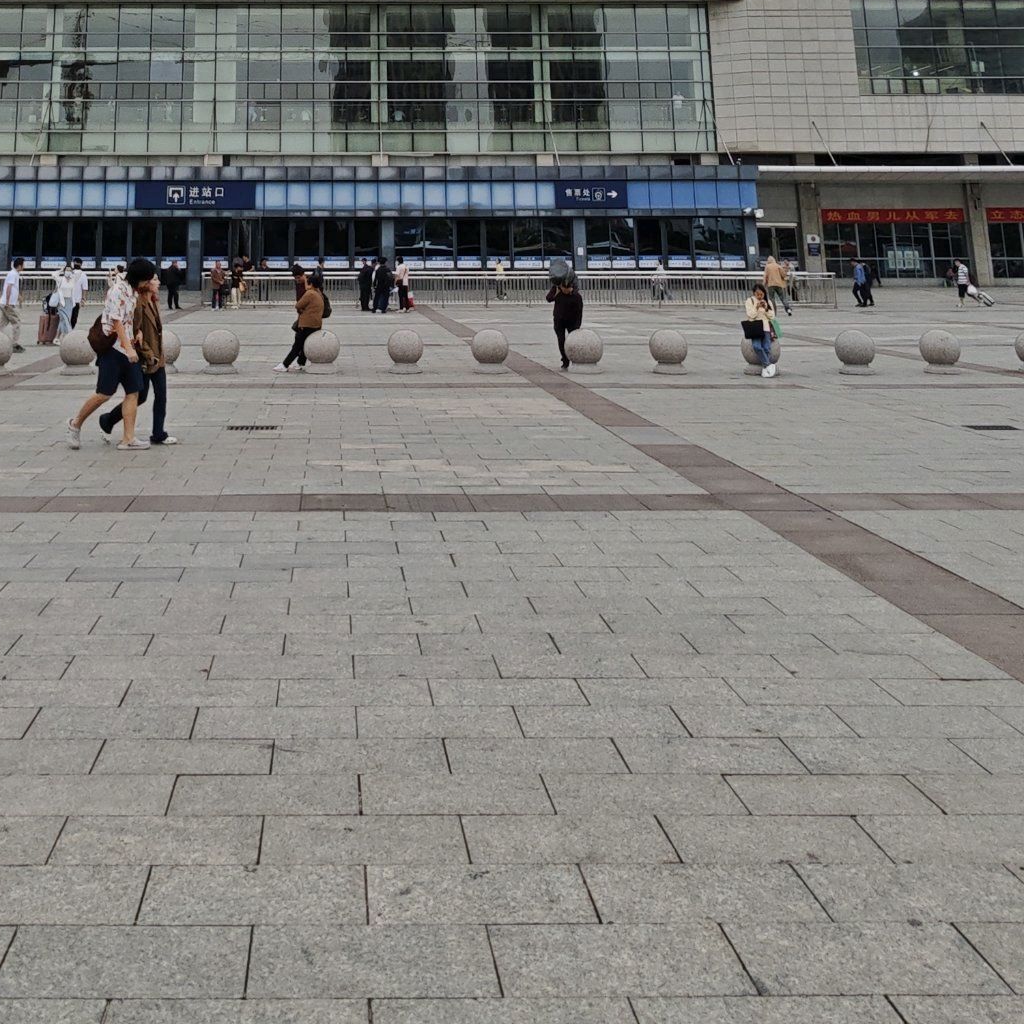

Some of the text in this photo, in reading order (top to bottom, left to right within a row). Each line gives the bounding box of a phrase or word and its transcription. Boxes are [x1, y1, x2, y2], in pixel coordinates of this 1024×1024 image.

[189, 186, 224, 197] 进站口
[565, 188, 590, 197] 售票处
[827, 211, 959, 221] 热血男儿从军去
